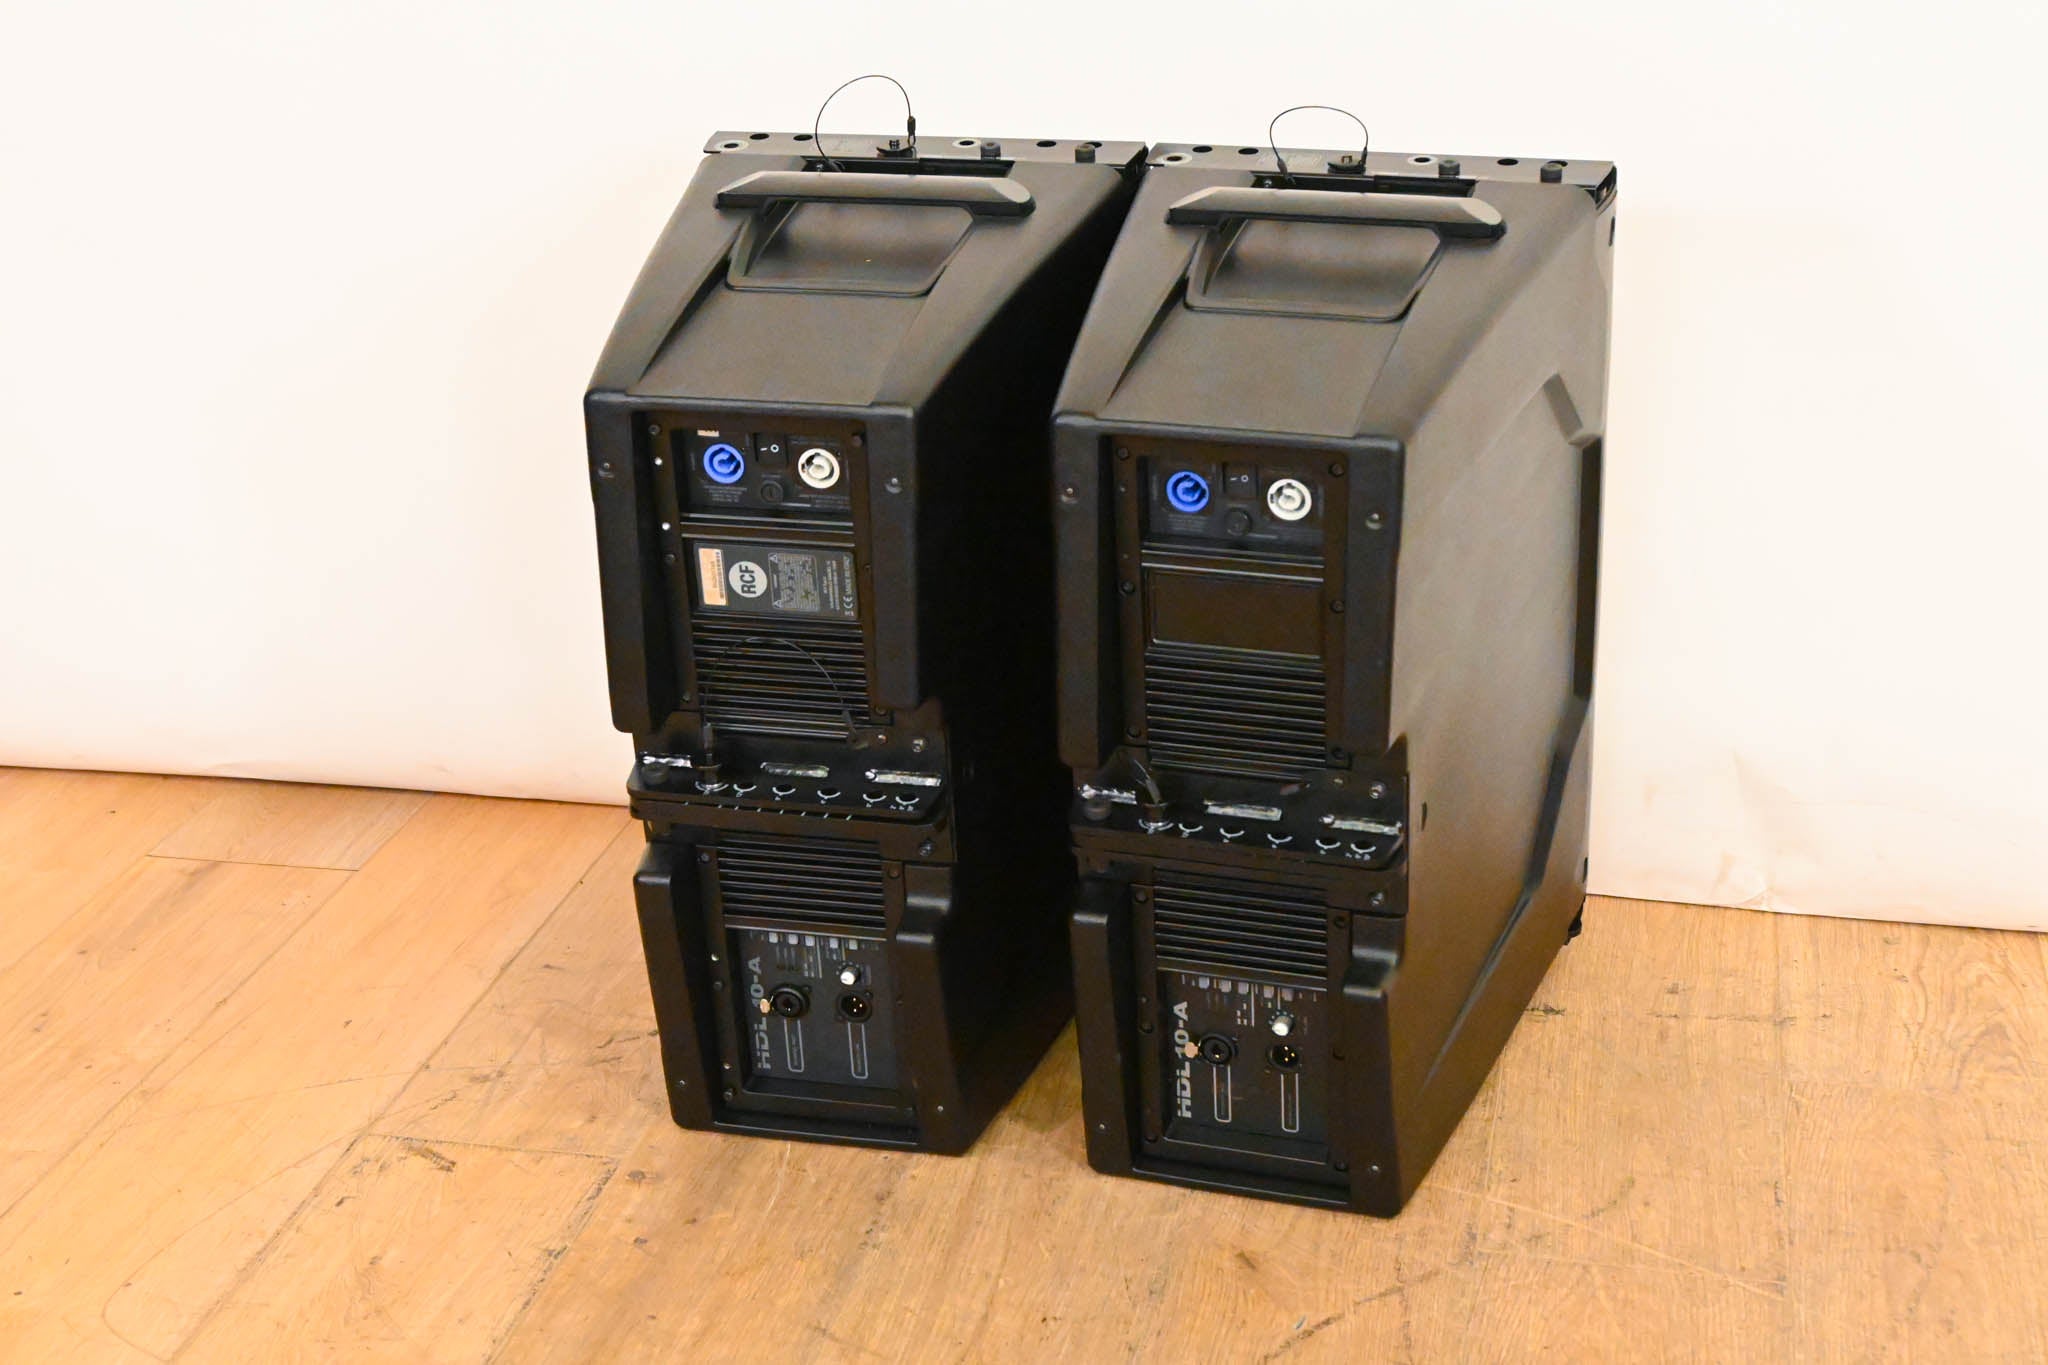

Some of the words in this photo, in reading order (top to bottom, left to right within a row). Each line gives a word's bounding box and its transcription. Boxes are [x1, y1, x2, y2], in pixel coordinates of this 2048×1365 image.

[739, 564, 757, 595] RCF
[747, 956, 766, 1008] 10-A
[754, 1016, 772, 1070] HDL
[1173, 1001, 1190, 1059] 10-A
[1175, 1061, 1192, 1119] HDL
